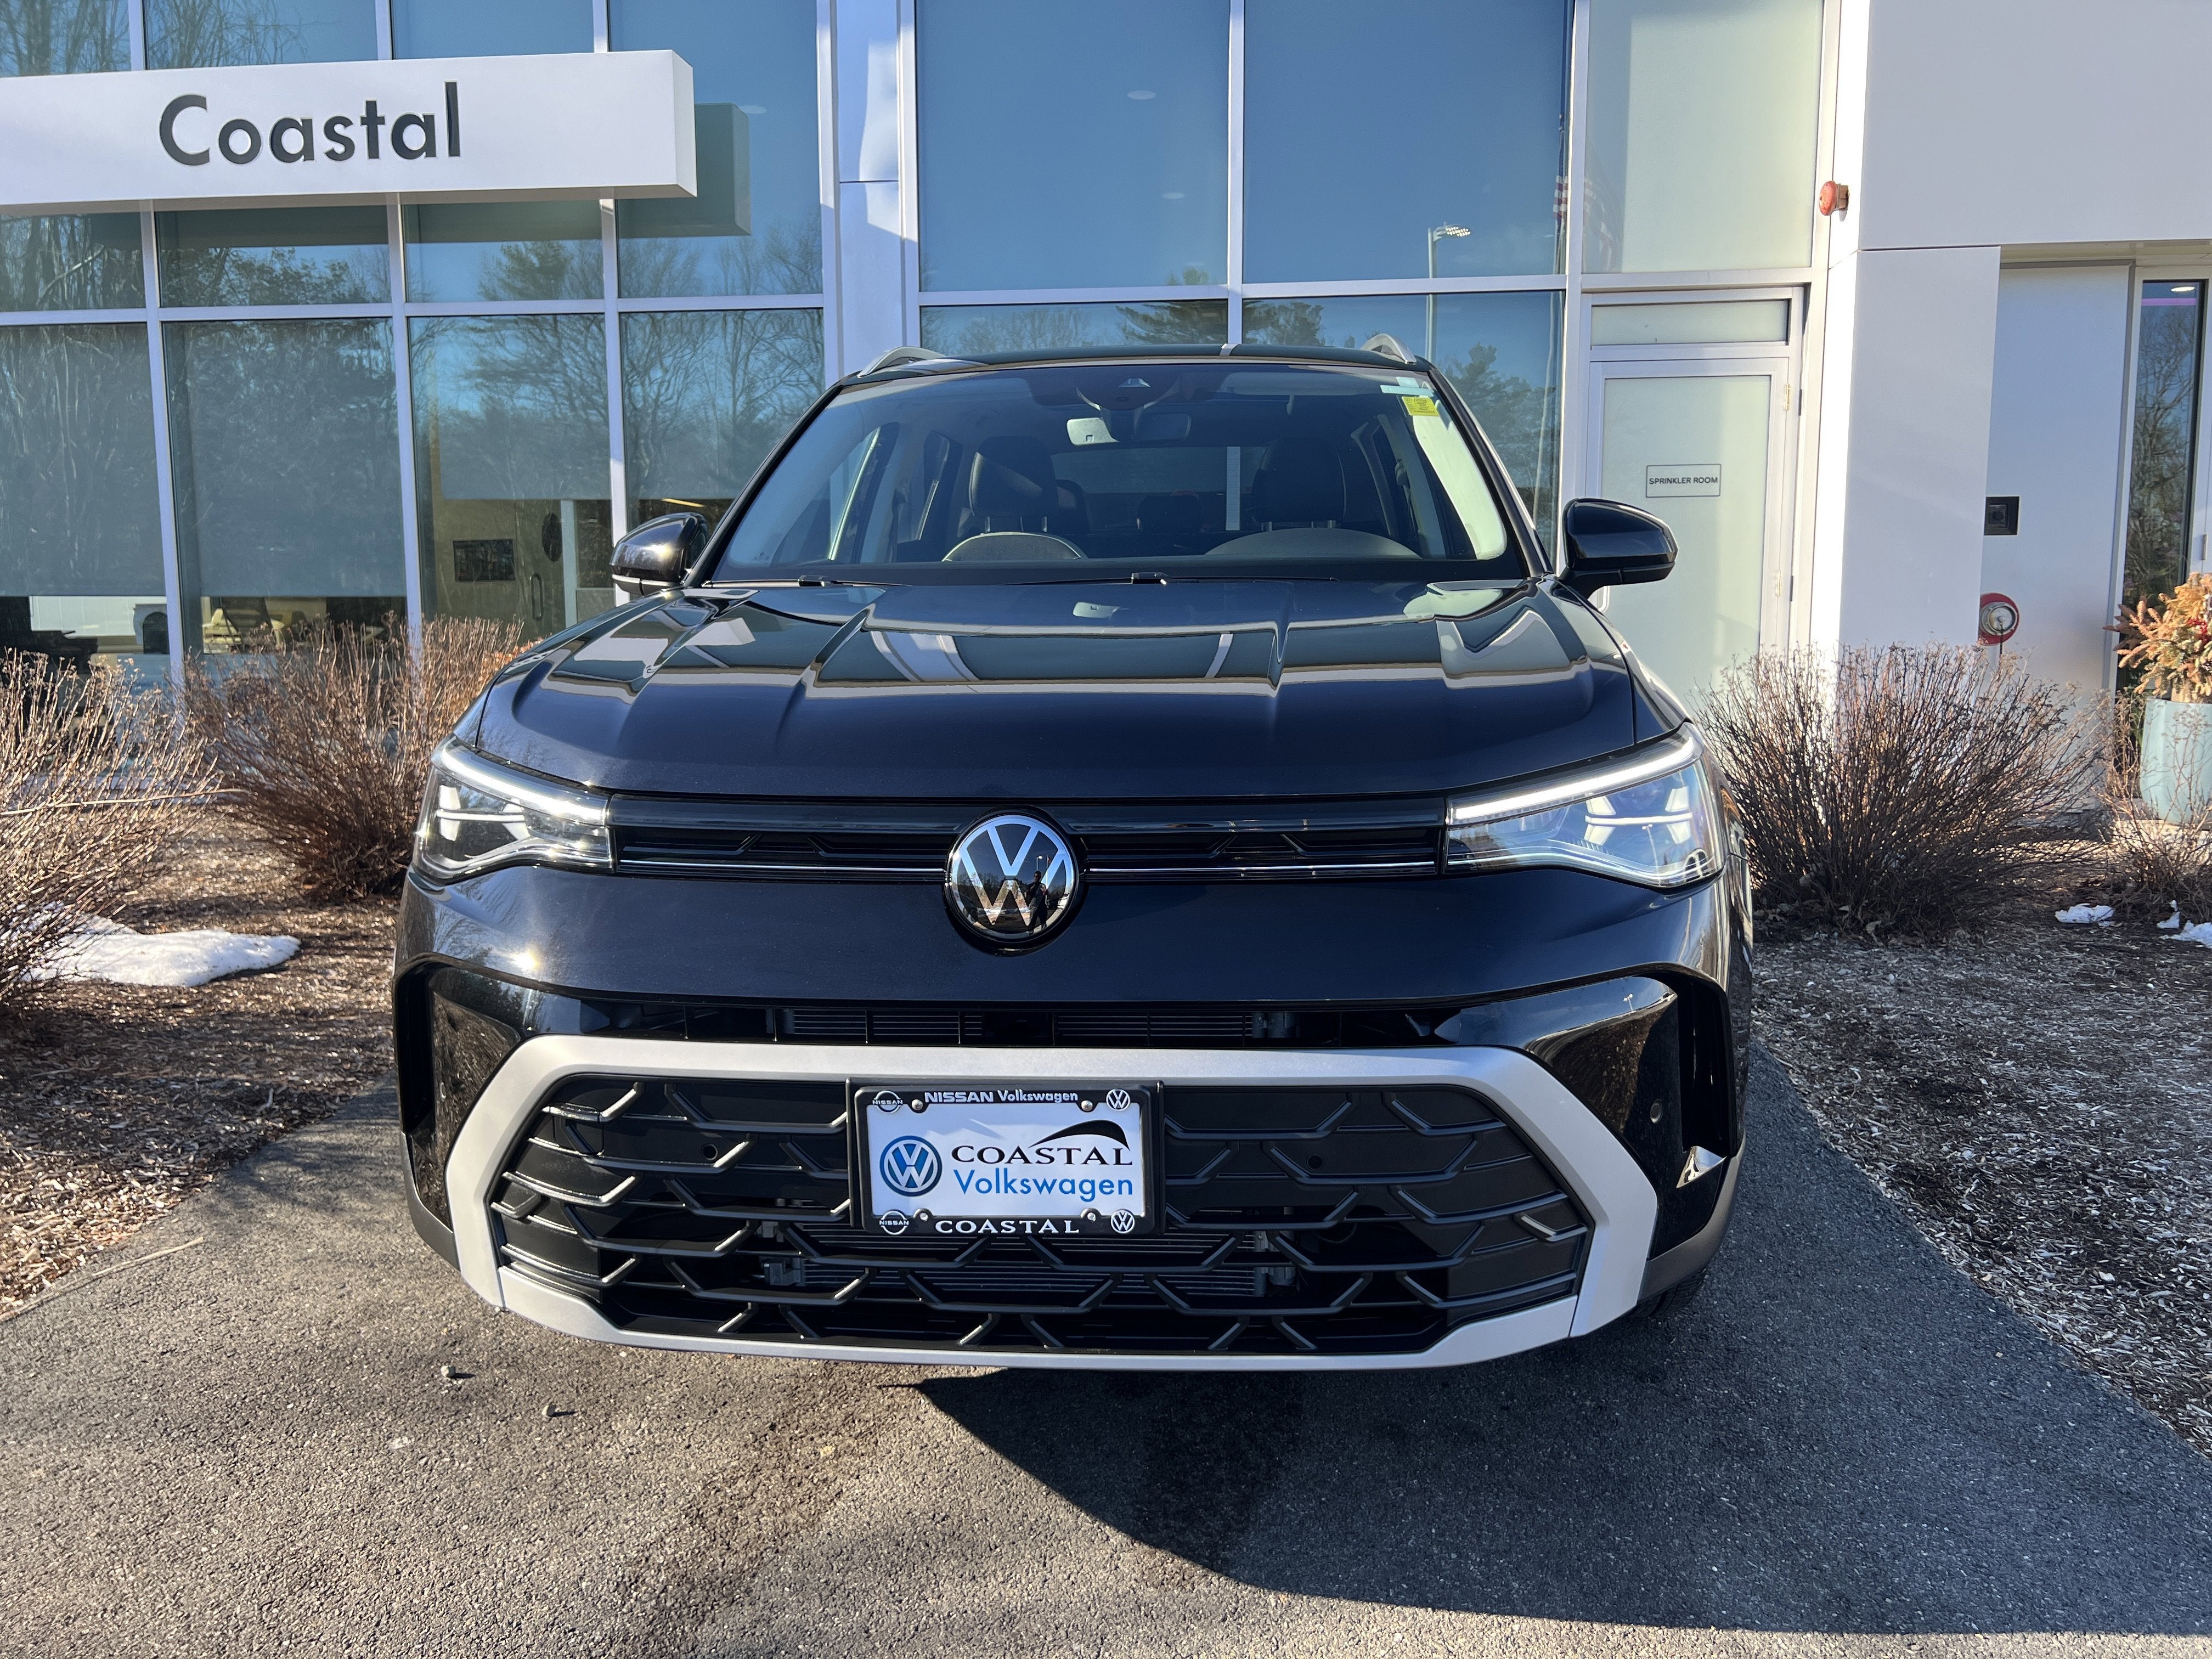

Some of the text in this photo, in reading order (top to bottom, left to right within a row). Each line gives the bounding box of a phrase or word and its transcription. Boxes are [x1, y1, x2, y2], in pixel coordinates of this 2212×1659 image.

[159, 80, 461, 166] Coastal
[952, 815, 1074, 938] VW
[924, 1088, 1079, 1103] NISSAN Volkswagen
[1106, 1089, 1131, 1111] VW
[879, 1135, 943, 1197] VW
[951, 1145, 1133, 1166] COASTAL
[952, 1167, 1133, 1203] Volkswagen
[935, 1218, 1080, 1234] COASTAL
[1110, 1210, 1135, 1234] VW
